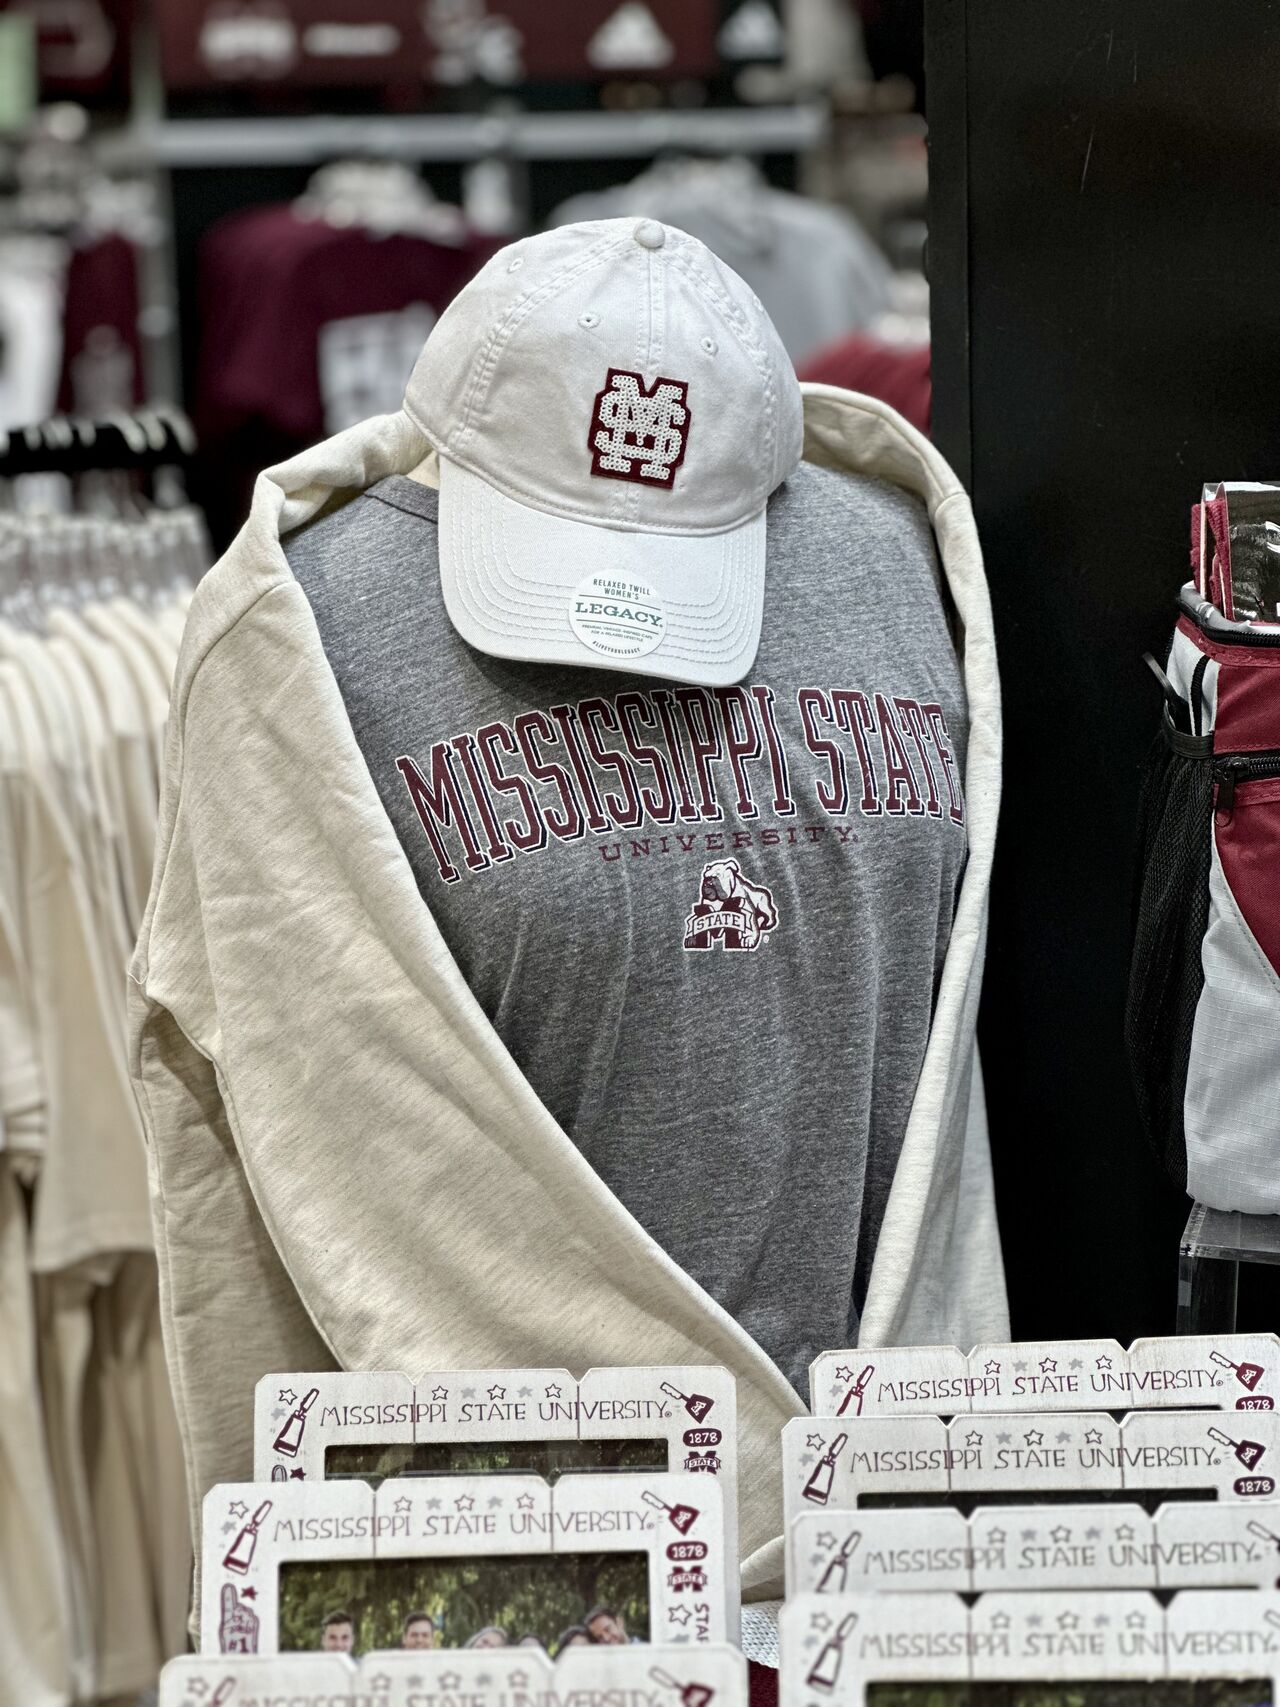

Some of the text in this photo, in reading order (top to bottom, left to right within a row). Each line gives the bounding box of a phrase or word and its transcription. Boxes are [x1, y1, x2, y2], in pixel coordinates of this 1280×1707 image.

[593, 579, 651, 596] RELAXED TWILL
[604, 588, 639, 600] WOMEN'S
[575, 602, 662, 626] LEGACY
[396, 685, 965, 884] MISSISSIPPI STATE
[599, 826, 853, 861] UNIVERSITY
[696, 913, 741, 931] STATE
[877, 1370, 1218, 1402] MISSISSIPPI STATE UNIVERSITY
[320, 1400, 668, 1426] MISSISSIPPI STATE UNIVERSITY
[1241, 1400, 1270, 1410] 1878
[688, 1432, 718, 1444] 1878
[850, 1446, 1218, 1473] MISSISSIPPI STATE UNIVERSITY
[1240, 1480, 1271, 1493] 1878
[273, 1511, 649, 1542] MISSISSIPPI STATE UNIVERSITY
[672, 1545, 704, 1558] 1878
[863, 1547, 1006, 1575] MISSISSIPPI
[1017, 1547, 1095, 1569] STATE
[859, 1633, 1009, 1659] MISSISSIPPI
[1023, 1633, 1102, 1656] STATE
